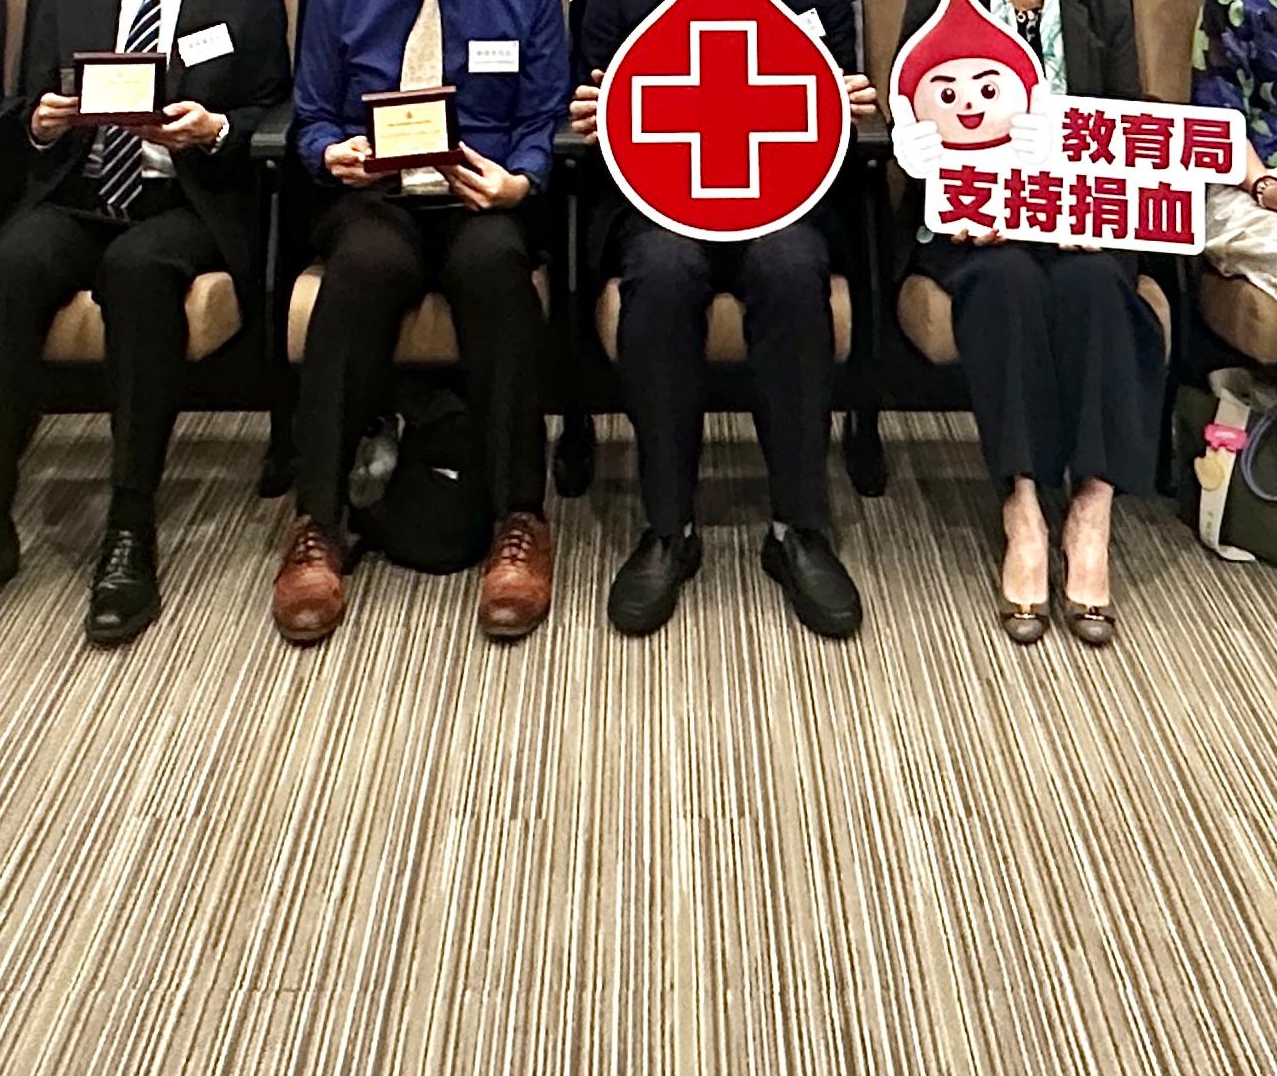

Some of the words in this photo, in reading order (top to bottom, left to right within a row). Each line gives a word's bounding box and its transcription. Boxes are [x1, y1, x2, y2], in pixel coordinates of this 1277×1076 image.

[1062, 107, 1234, 174] 教育局
[938, 165, 1196, 245] 支持捐血
